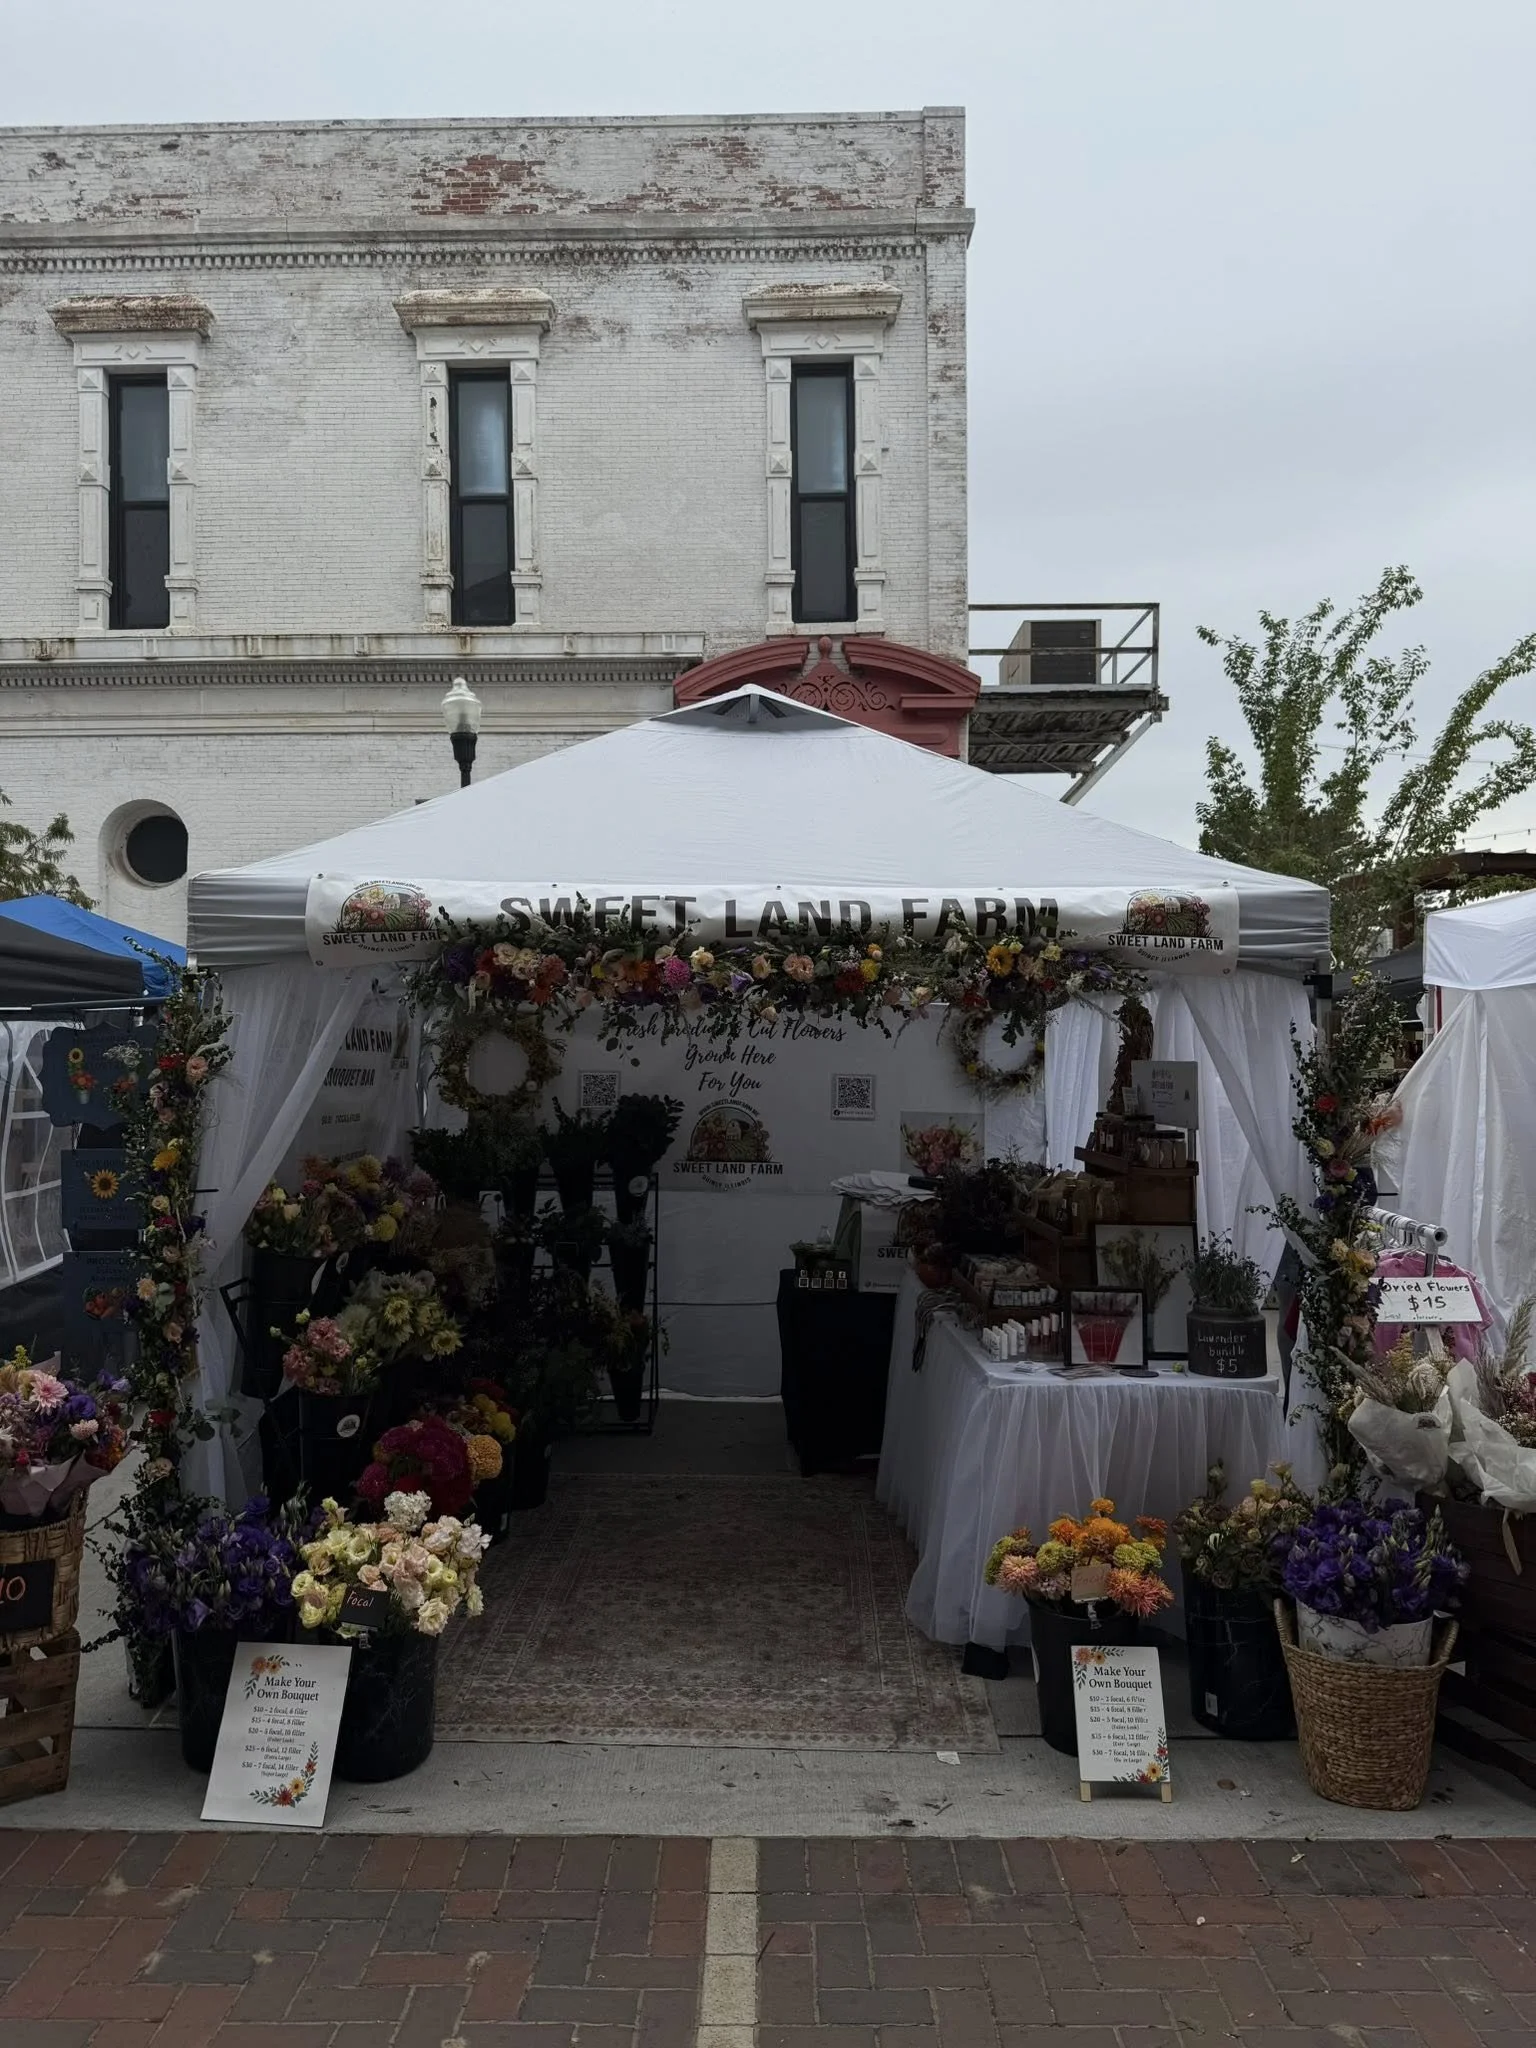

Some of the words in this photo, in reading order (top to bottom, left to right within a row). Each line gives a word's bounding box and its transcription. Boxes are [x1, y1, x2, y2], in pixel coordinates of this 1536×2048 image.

[500, 894, 696, 935] SWEET
[725, 898, 873, 937] LAND
[901, 896, 1060, 937] FARM
[322, 933, 366, 946] SWEET
[372, 932, 406, 943] LAND
[1108, 934, 1148, 947] SWEET
[1154, 938, 1185, 949] LAND
[1191, 939, 1223, 951] FARM
[783, 1018, 847, 1042] Flowers
[369, 1029, 392, 1053] FARM
[685, 1044, 735, 1071] Grown
[741, 1045, 776, 1066] Here
[324, 1067, 361, 1088] OUQUET
[361, 1068, 376, 1087] BAR
[698, 1071, 726, 1092] For
[728, 1071, 763, 1097] You
[673, 1163, 711, 1174] SWEET
[715, 1163, 746, 1174] LAND
[750, 1164, 784, 1175] FARM
[877, 1247, 908, 1259] SWE
[1381, 1280, 1421, 1292] Dried
[1427, 1281, 1470, 1292] Flowers
[1408, 1294, 1447, 1313] $15
[1215, 1357, 1238, 1374] $5
[347, 1590, 375, 1607] Focal
[1094, 1666, 1121, 1676] Make
[1123, 1666, 1146, 1676] Your
[264, 1676, 292, 1687] Make
[294, 1677, 317, 1688] Your
[1089, 1679, 1111, 1688] Own
[1114, 1679, 1152, 1691] Bouquet
[257, 1688, 279, 1699] Own
[281, 1690, 319, 1703] Bouquet
